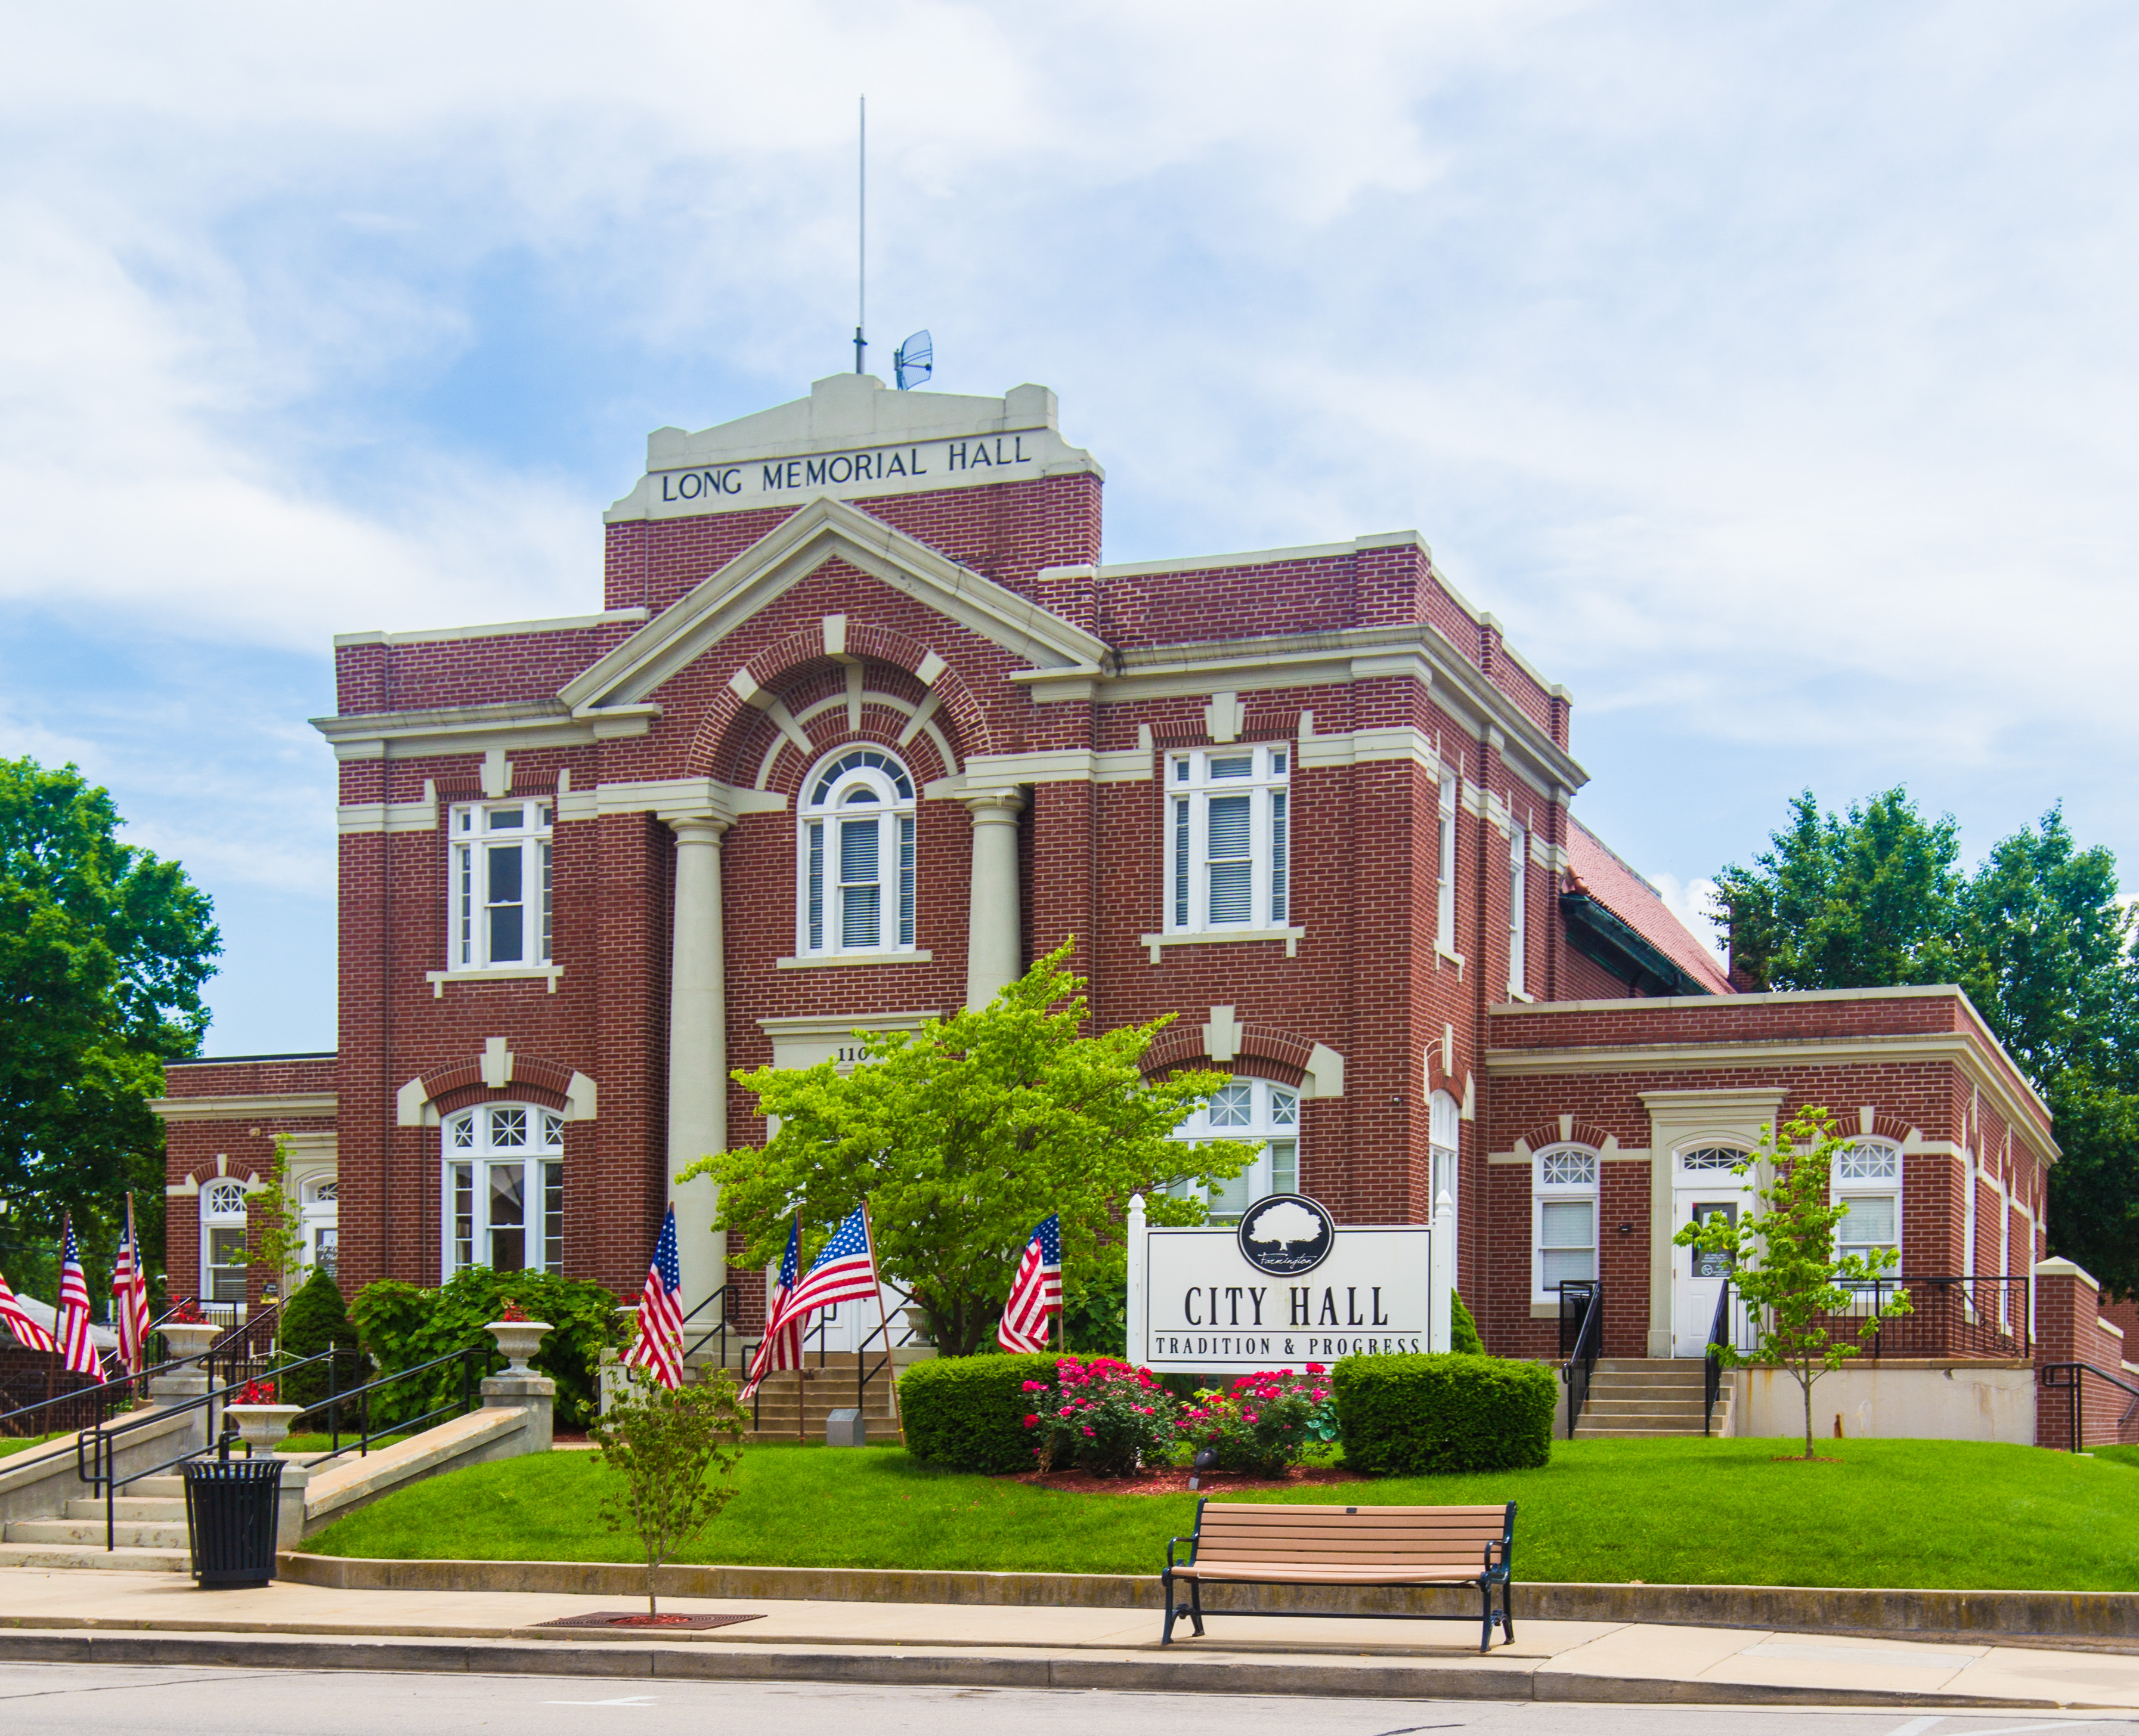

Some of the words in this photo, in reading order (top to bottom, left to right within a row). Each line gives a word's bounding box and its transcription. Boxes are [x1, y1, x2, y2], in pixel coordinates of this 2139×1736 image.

[663, 469, 741, 502] LONG
[763, 448, 927, 491] MEMORIAL
[949, 436, 1032, 471] HALL
[838, 1047, 868, 1061] 110
[1258, 1252, 1317, 1269] Farmington
[1185, 1287, 1267, 1325] CITY
[1290, 1286, 1388, 1325] HALL
[1156, 1338, 1270, 1354] TRADITION
[1285, 1338, 1295, 1354] &
[1310, 1338, 1419, 1355] PROGRESS
